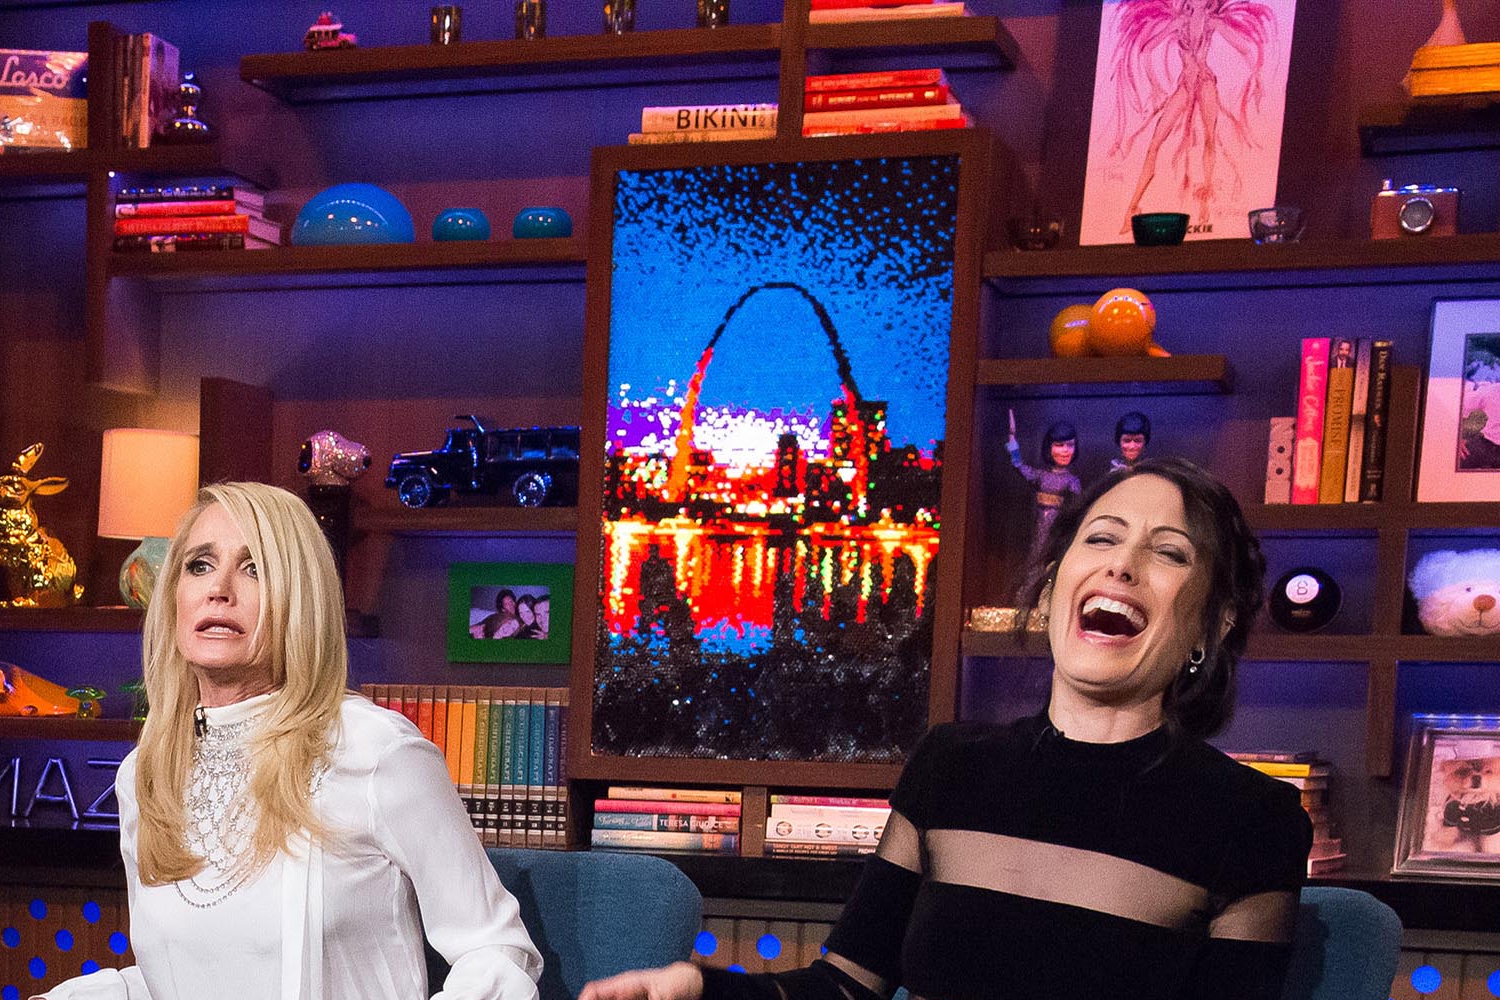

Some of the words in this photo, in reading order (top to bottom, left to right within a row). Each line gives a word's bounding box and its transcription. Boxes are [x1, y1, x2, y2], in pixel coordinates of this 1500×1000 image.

[676, 107, 758, 130] BIKINI
[1186, 224, 1214, 234] CKIE
[1297, 580, 1309, 596] 8
[659, 819, 689, 828] TERESA
